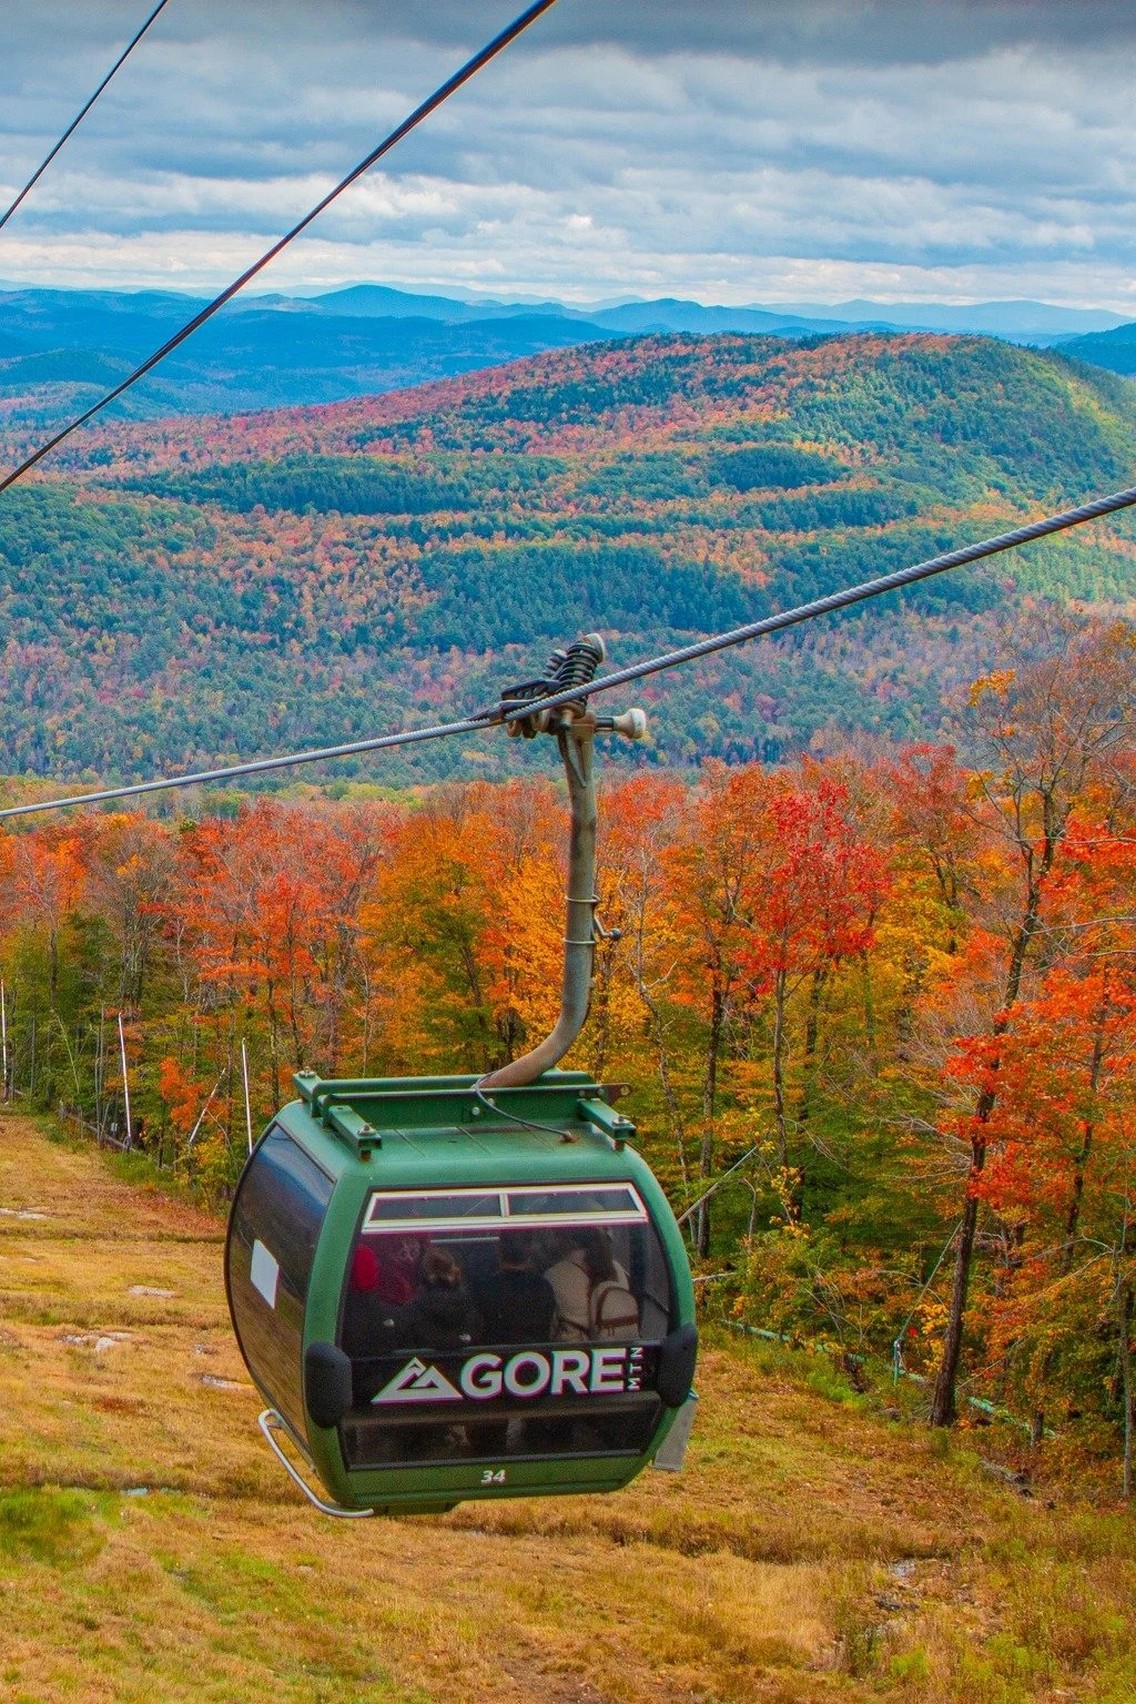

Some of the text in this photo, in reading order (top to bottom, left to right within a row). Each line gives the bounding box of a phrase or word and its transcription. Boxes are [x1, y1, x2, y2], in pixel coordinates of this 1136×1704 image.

[461, 1348, 626, 1399] GORE
[626, 1346, 644, 1392] MTN
[480, 1469, 506, 1484] 34
